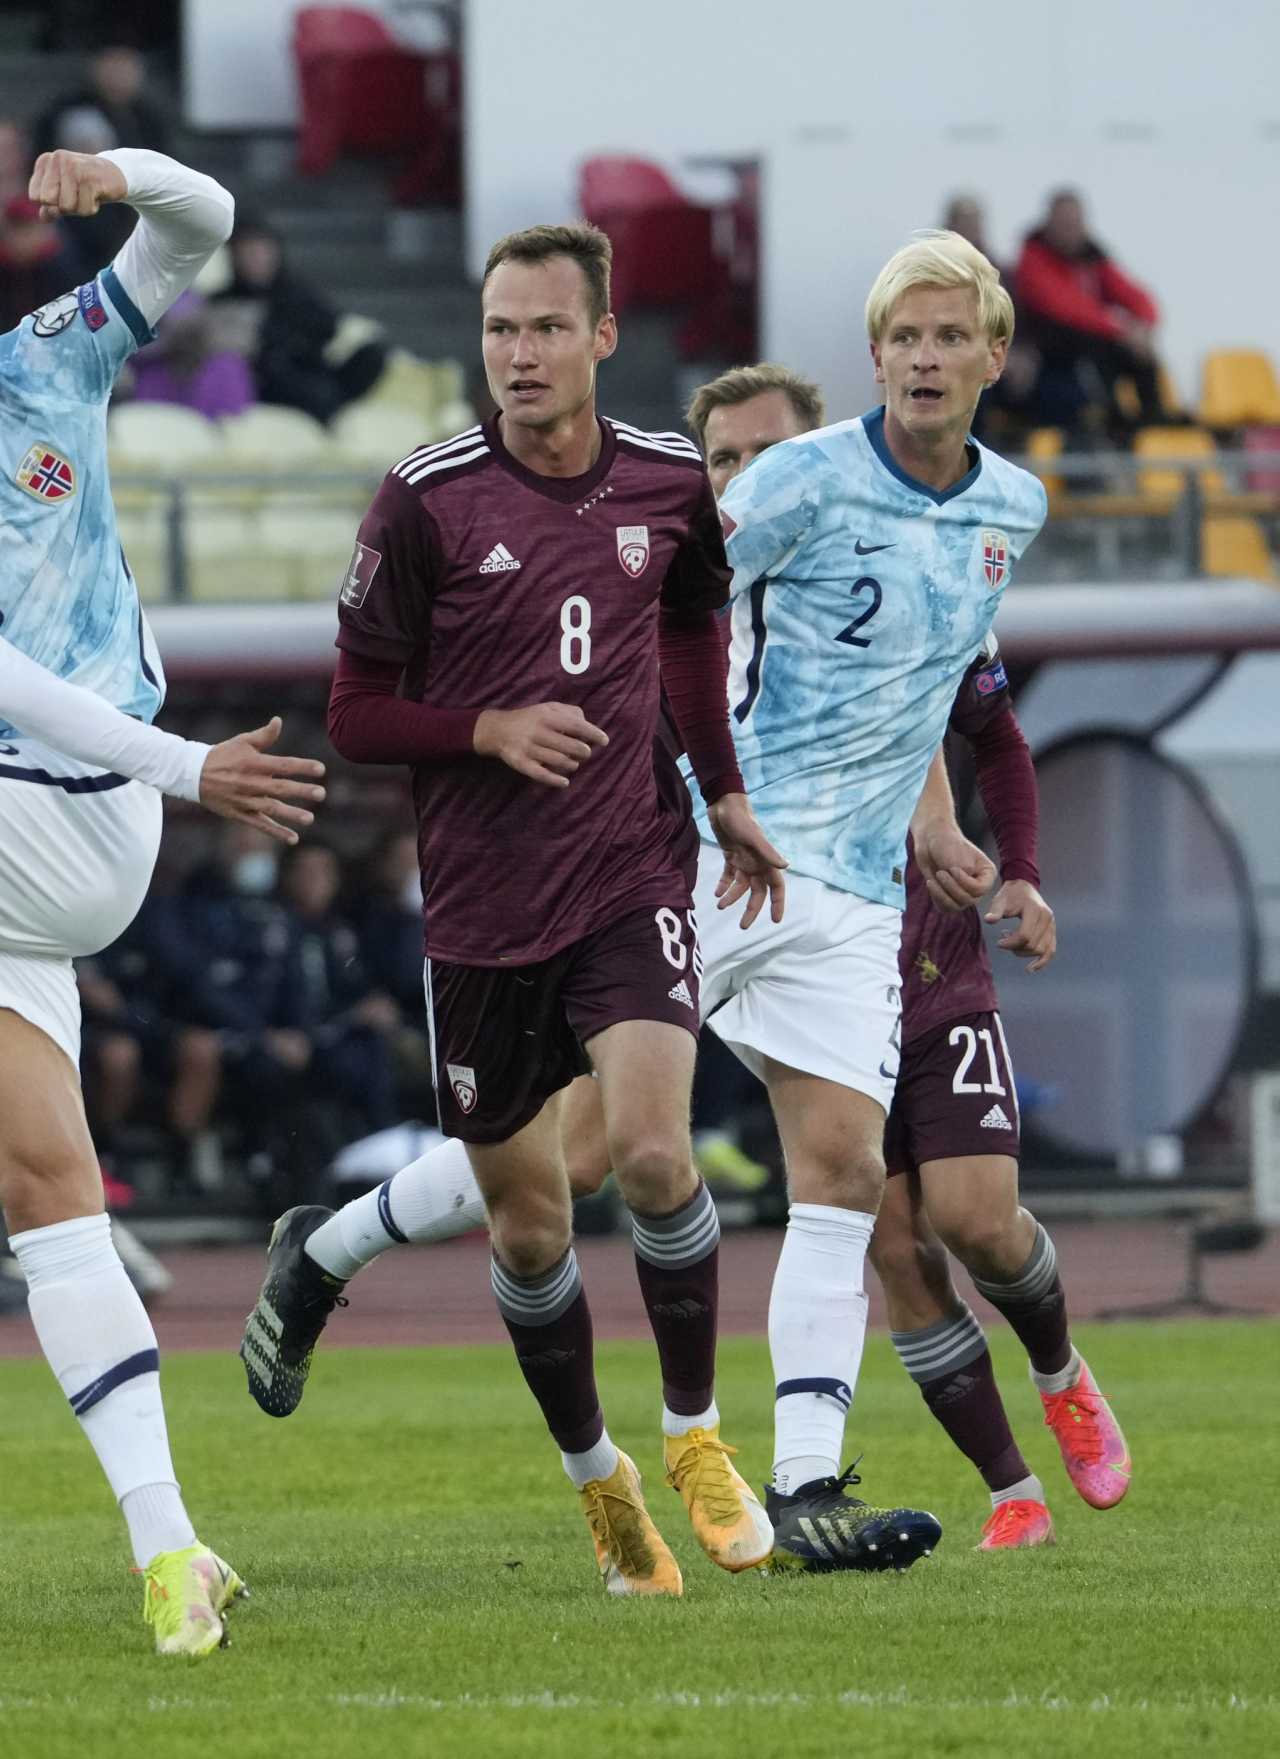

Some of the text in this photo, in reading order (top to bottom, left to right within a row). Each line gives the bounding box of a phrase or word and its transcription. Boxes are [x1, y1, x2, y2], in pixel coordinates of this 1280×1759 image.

[479, 560, 521, 574] adidas
[560, 595, 591, 675] 8
[832, 576, 883, 649] 2
[654, 907, 687, 970] 8
[947, 1025, 1006, 1097] 21
[979, 1119, 1013, 1131] adidas
